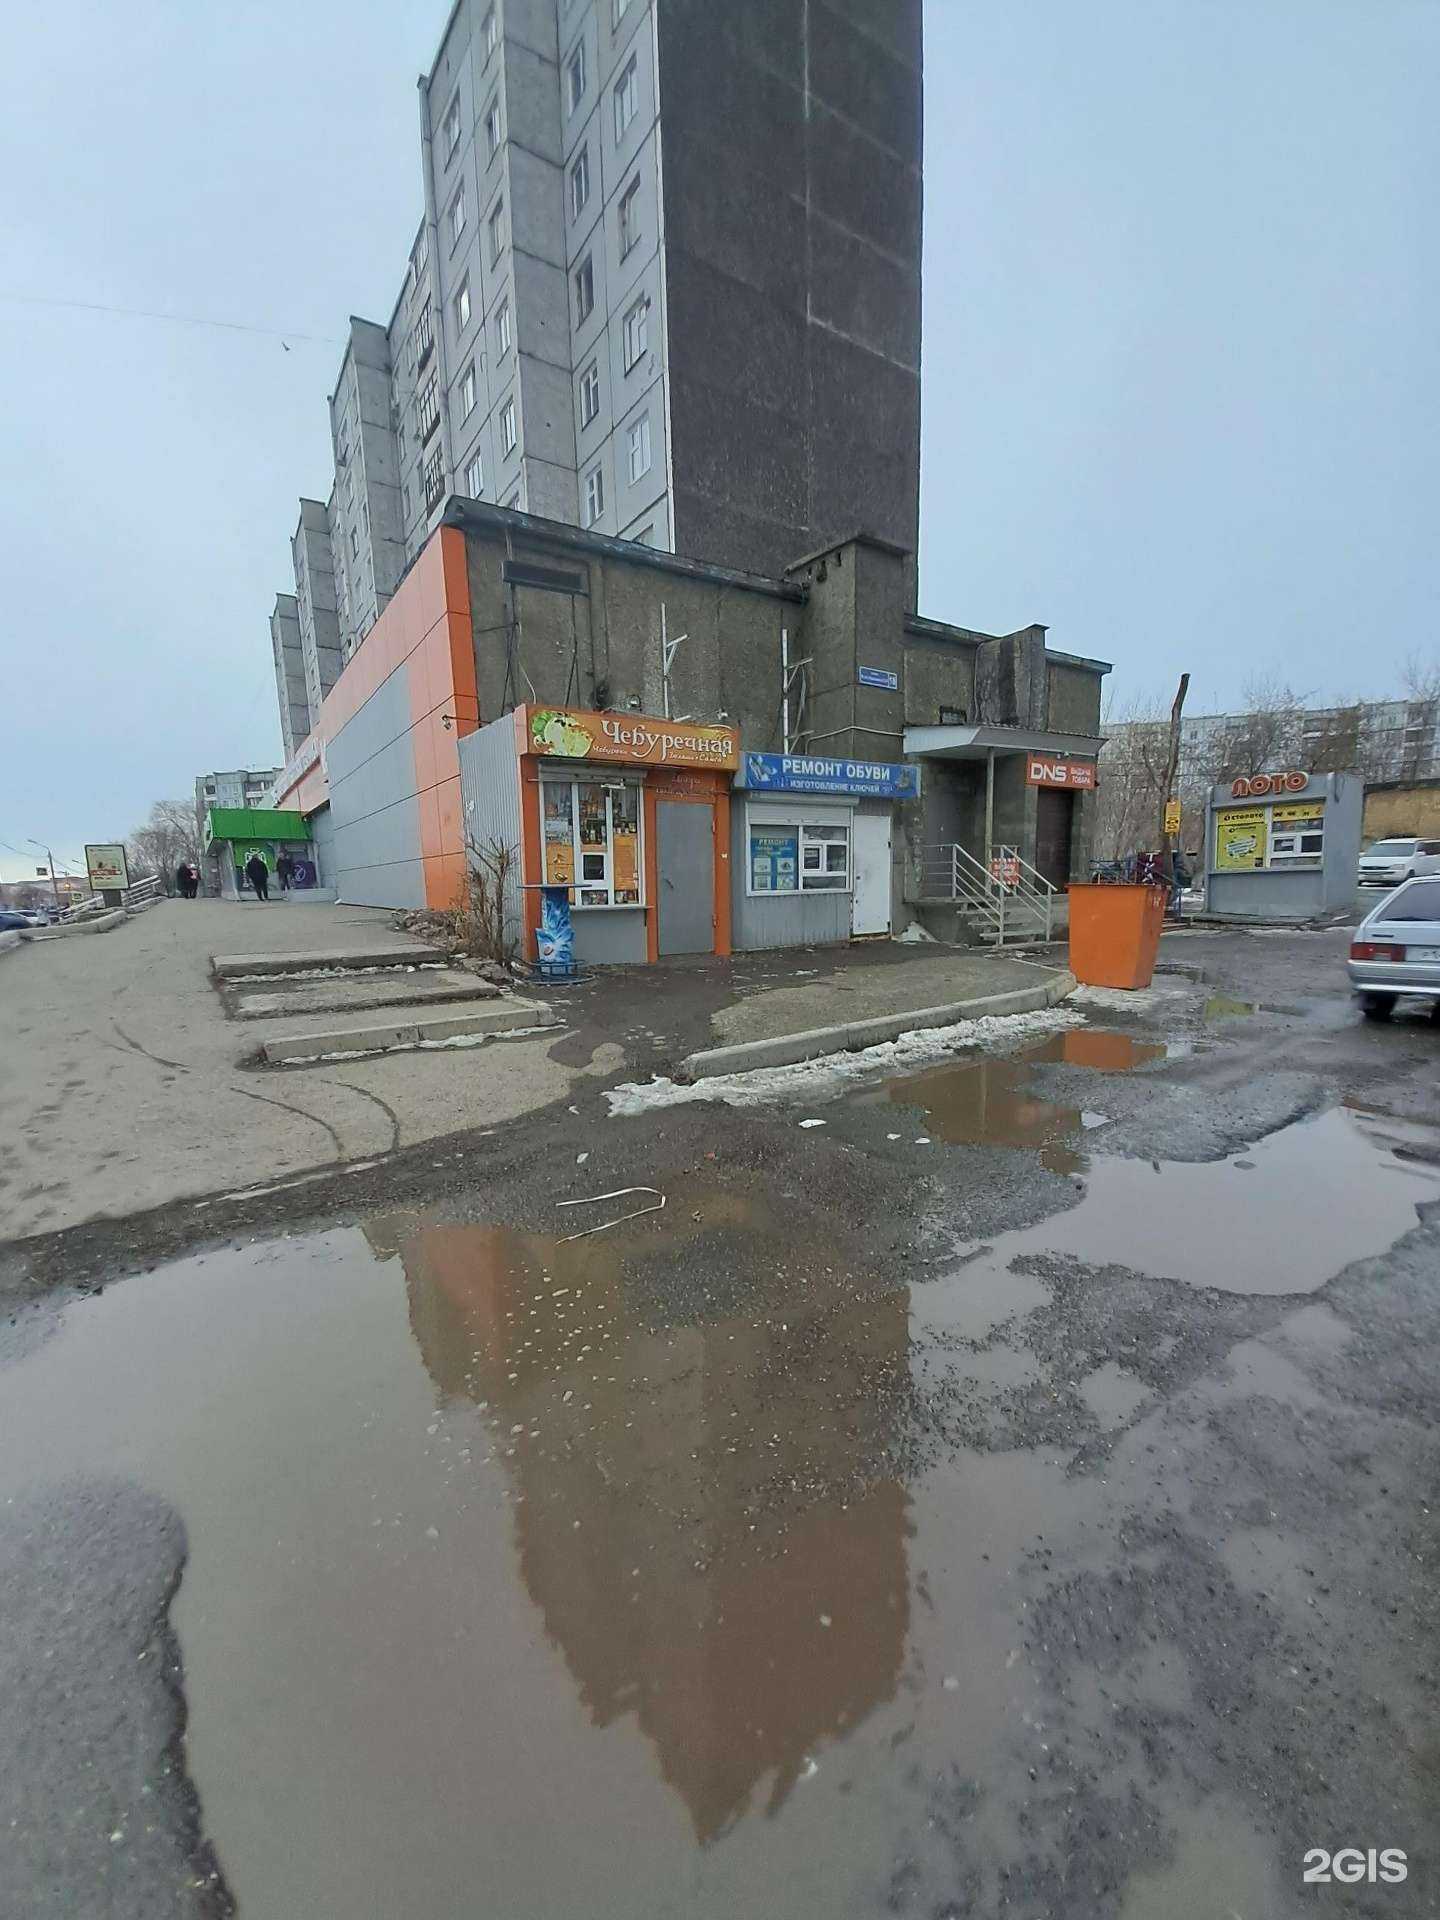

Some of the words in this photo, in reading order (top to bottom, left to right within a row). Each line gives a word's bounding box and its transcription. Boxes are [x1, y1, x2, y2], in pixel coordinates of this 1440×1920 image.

[600, 719, 733, 760] Чебуречная
[782, 758, 842, 777] РЕМОНТ
[846, 764, 890, 781] ОБУВИ
[1030, 762, 1067, 782] DNS
[790, 779, 849, 792] ИЗГОТОВЛЕНИЕ
[849, 783, 880, 793] КЛЮЧЕЙ
[1232, 771, 1309, 798] ЛОТО
